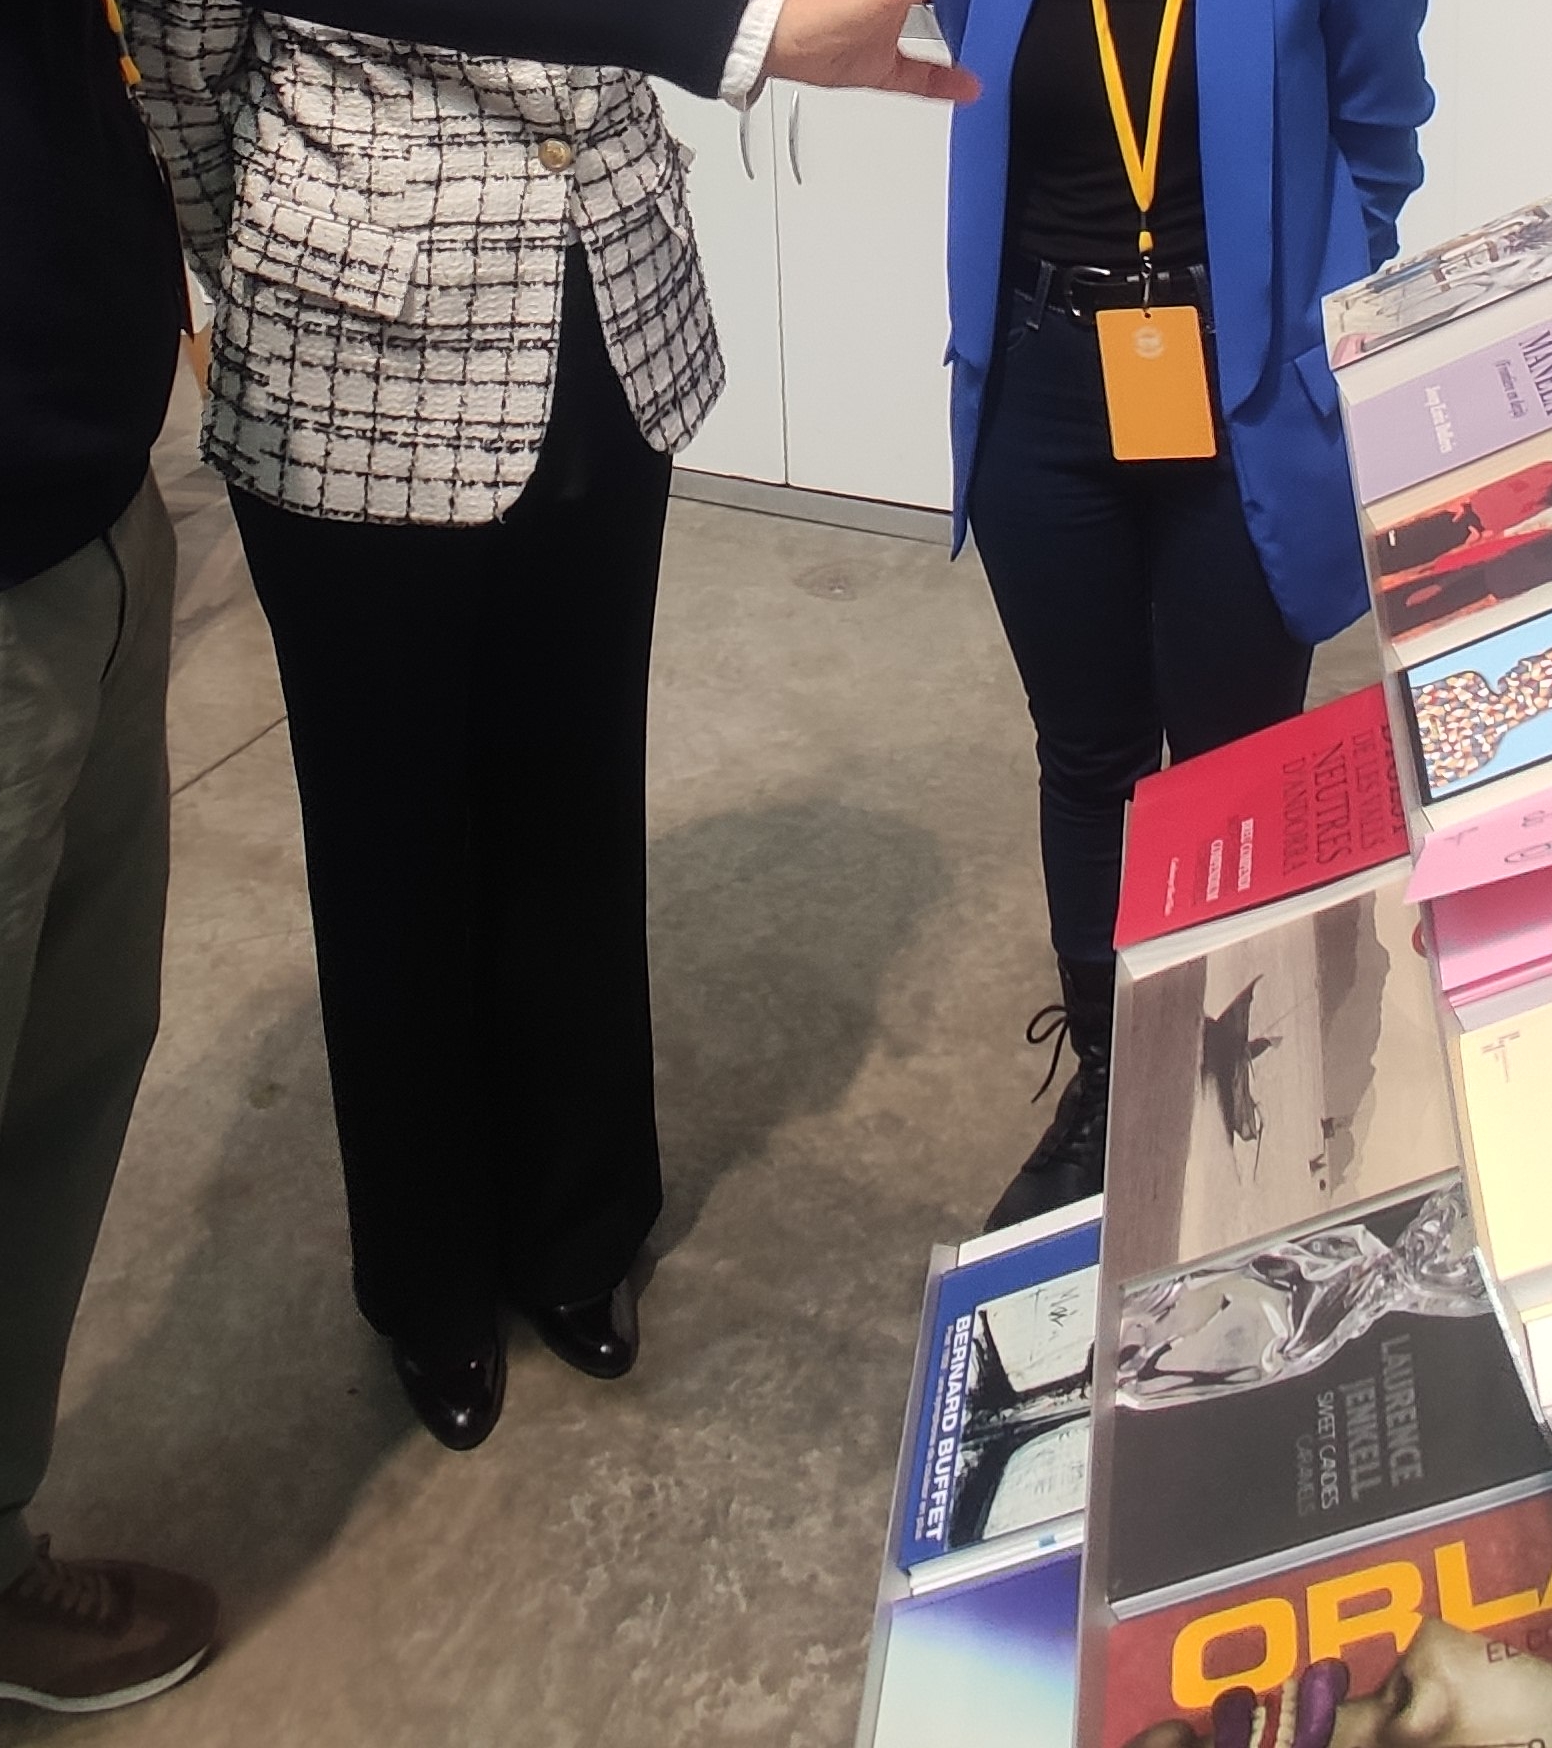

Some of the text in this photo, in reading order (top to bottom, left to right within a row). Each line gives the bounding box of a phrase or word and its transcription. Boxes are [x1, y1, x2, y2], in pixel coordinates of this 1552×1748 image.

[1311, 740, 1353, 866] NEUTRES
[941, 1313, 971, 1432] BERNARD
[1317, 1390, 1336, 1440] SWEET
[1380, 1333, 1423, 1487] LAURENCE
[924, 1436, 955, 1542] BUFFET
[1337, 1377, 1383, 1501] JENKELL
[1486, 1639, 1520, 1664] EL
